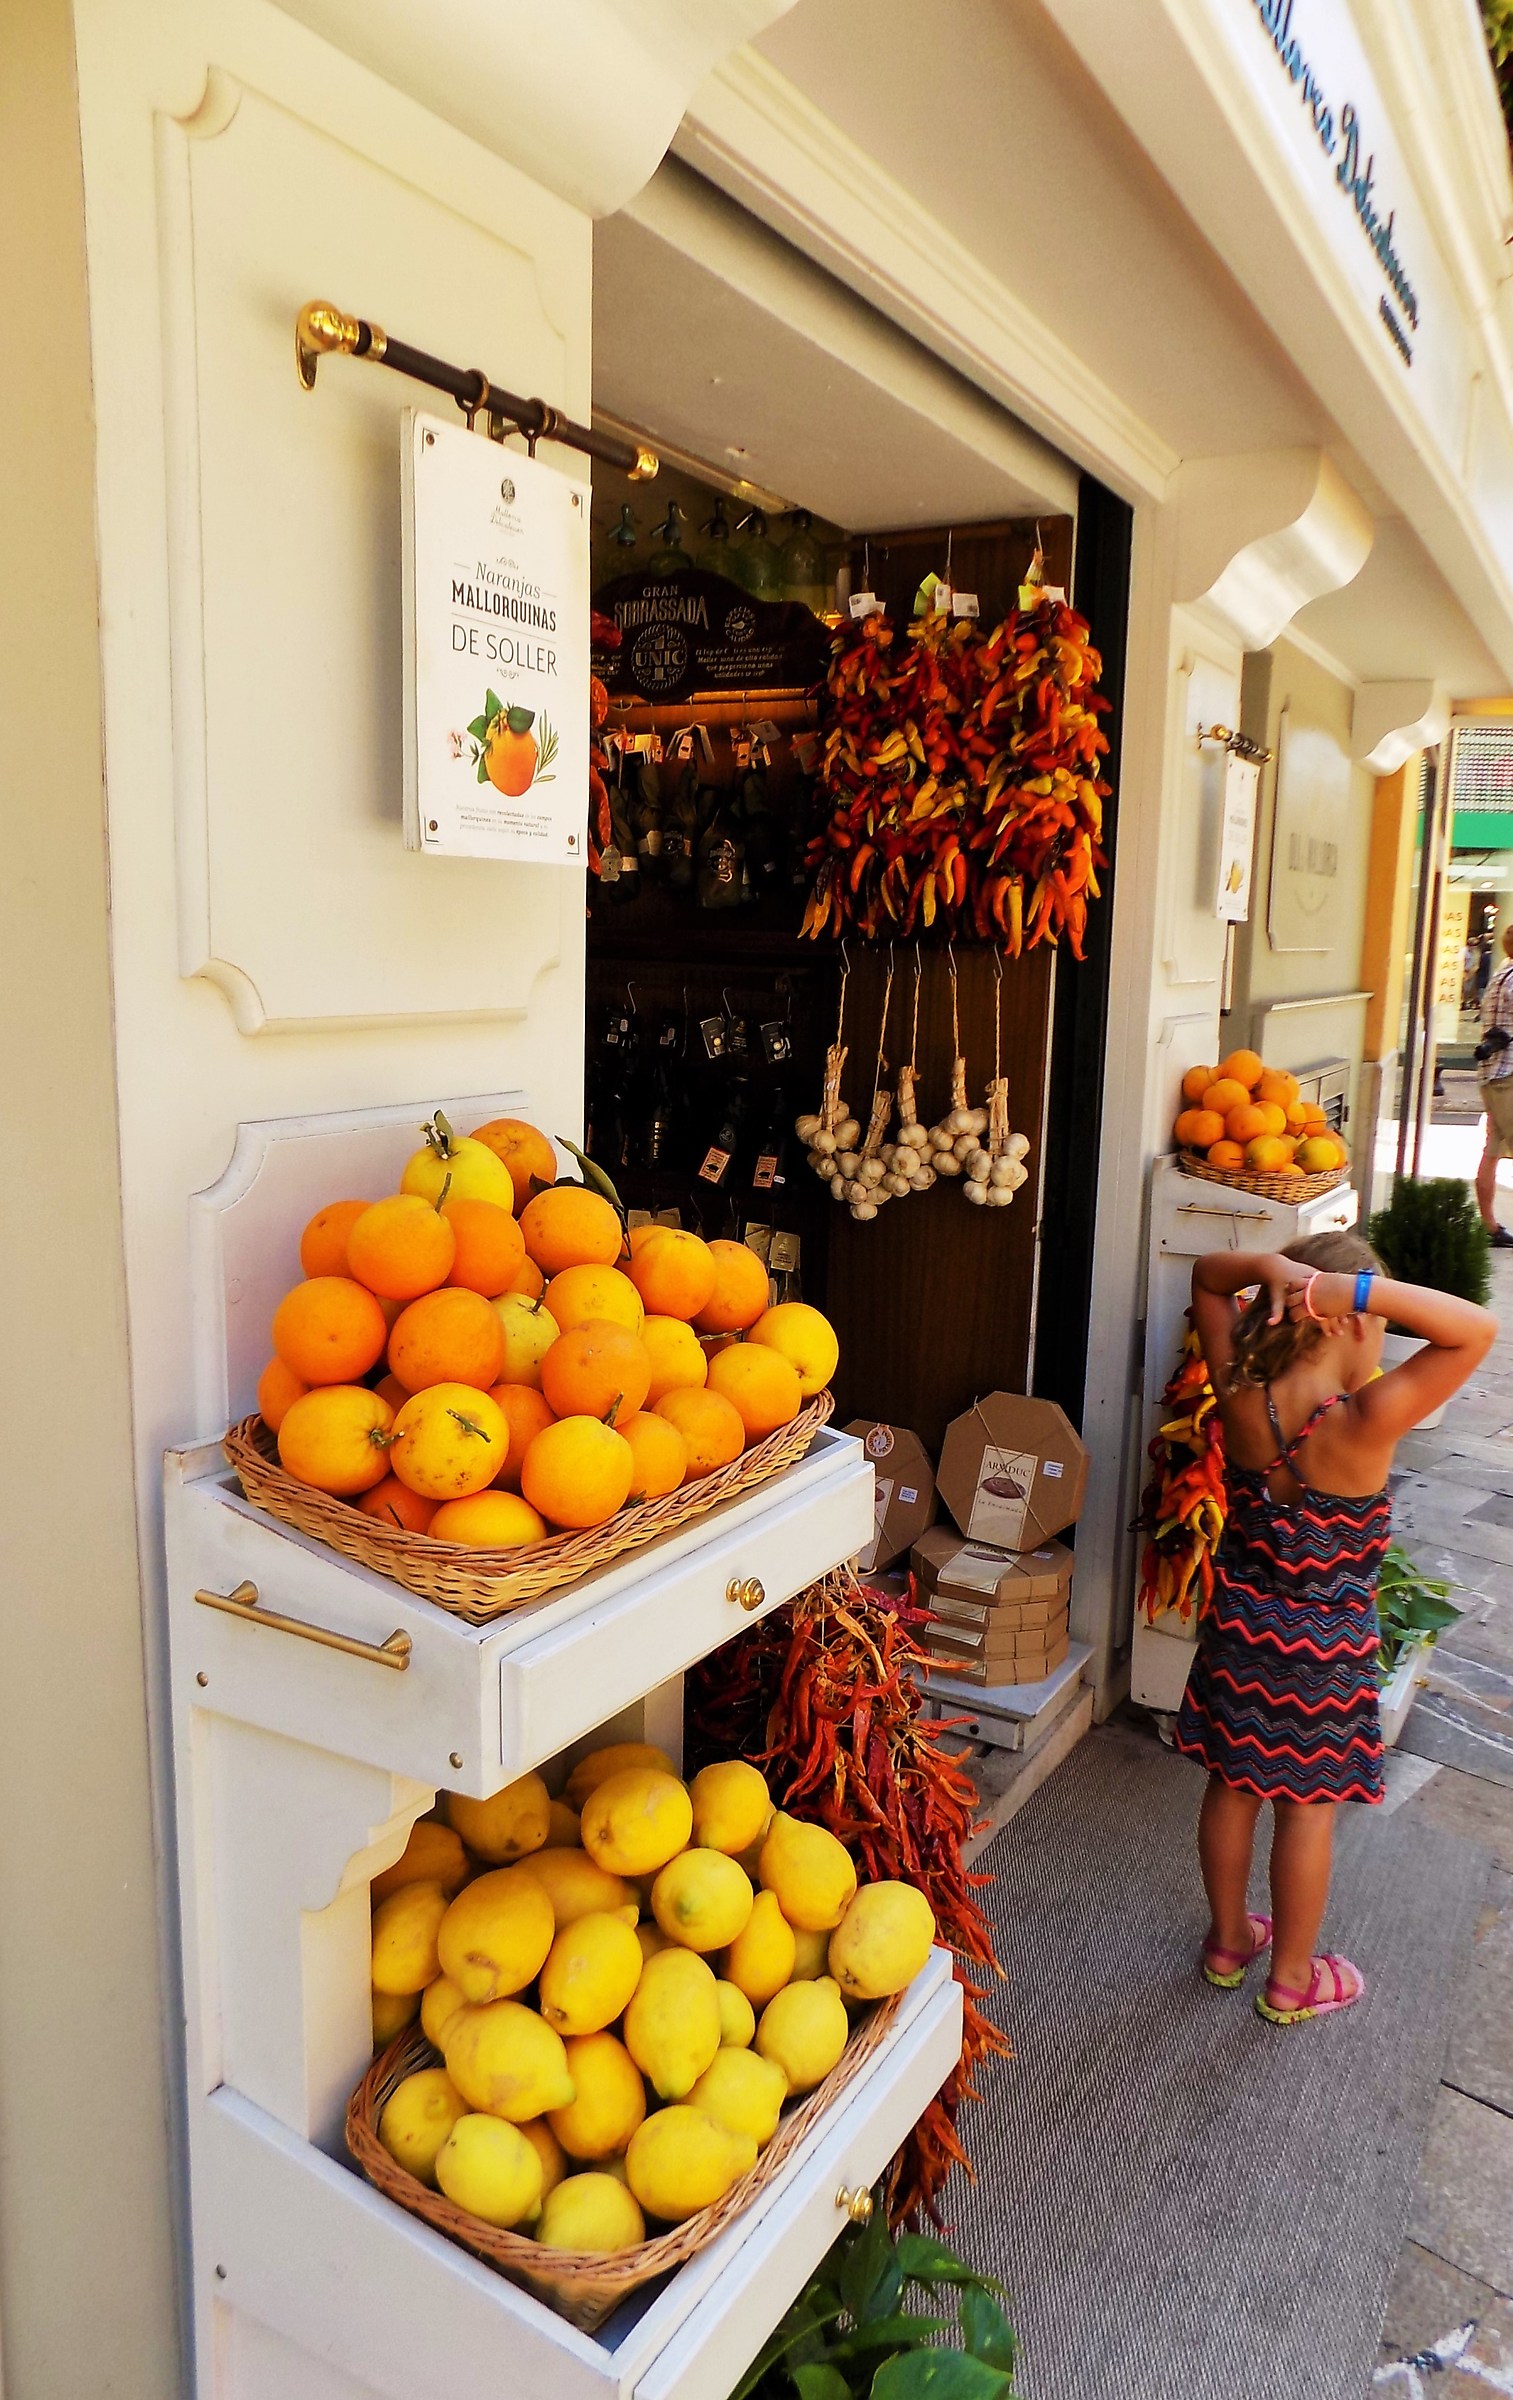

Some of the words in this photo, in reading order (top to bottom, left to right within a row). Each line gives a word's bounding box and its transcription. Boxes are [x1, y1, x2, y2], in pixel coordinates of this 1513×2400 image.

[475, 561, 541, 599] Naranjas
[643, 585, 678, 598] GRAN
[452, 579, 557, 632] MALLORQUINAS
[614, 595, 709, 632] SOBRASSADA
[452, 623, 479, 656] DE
[486, 634, 558, 677] SOLLER
[635, 649, 684, 667] UNIC
